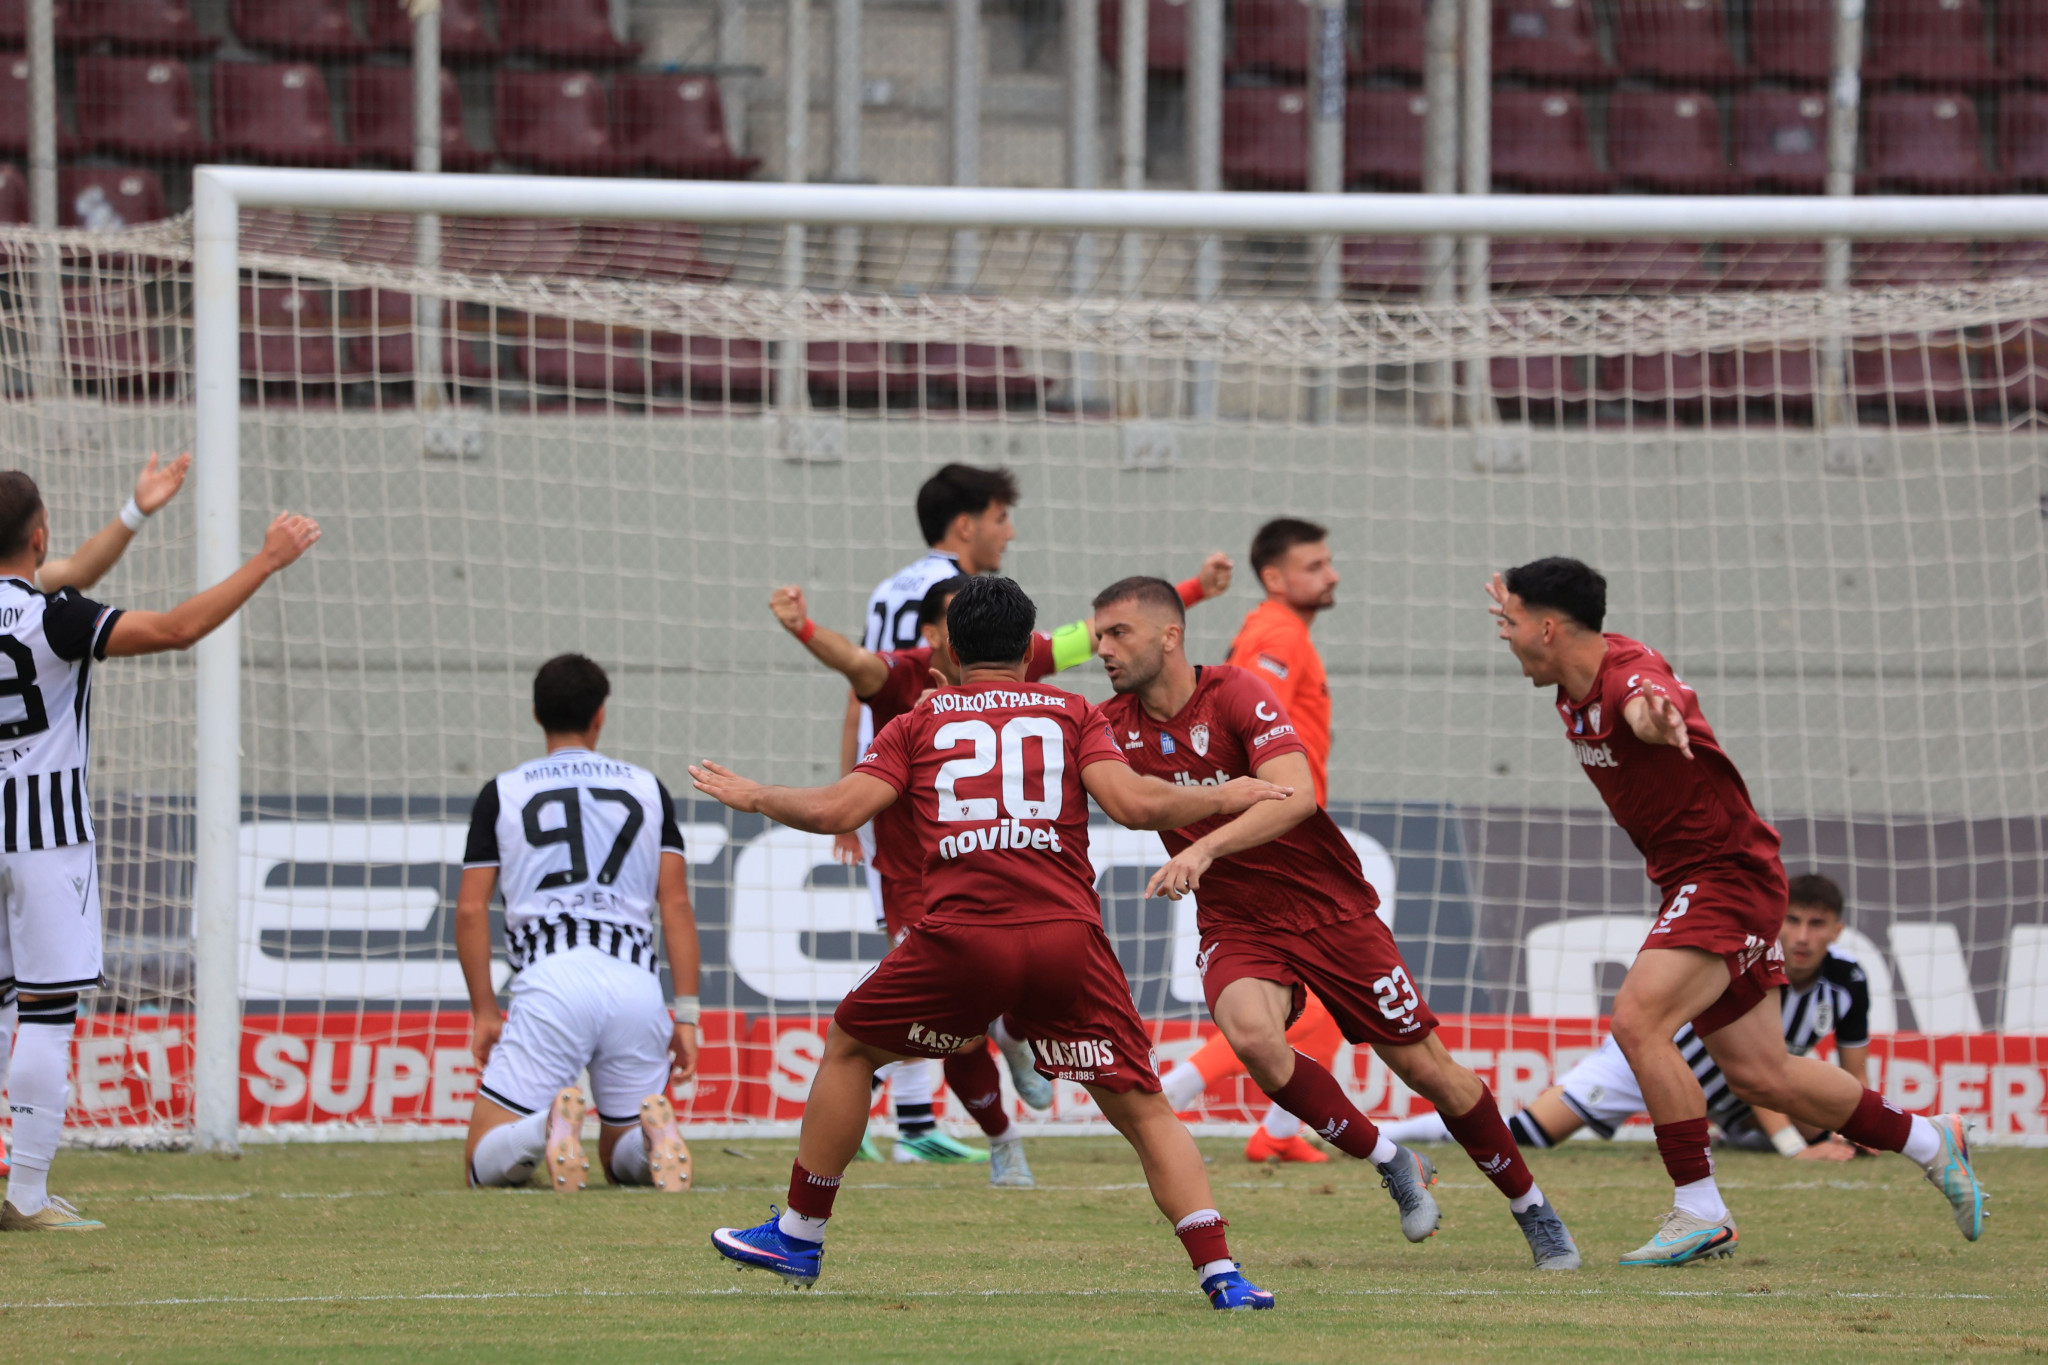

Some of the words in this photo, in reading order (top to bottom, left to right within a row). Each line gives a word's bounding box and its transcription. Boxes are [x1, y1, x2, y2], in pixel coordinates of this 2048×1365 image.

[933, 716, 1066, 822] 20
[521, 786, 645, 893] 97
[938, 818, 1063, 861] novibet
[1663, 883, 1698, 920] 6
[1372, 964, 1419, 1020] 23
[1058, 1069, 1095, 1081] est.1885
